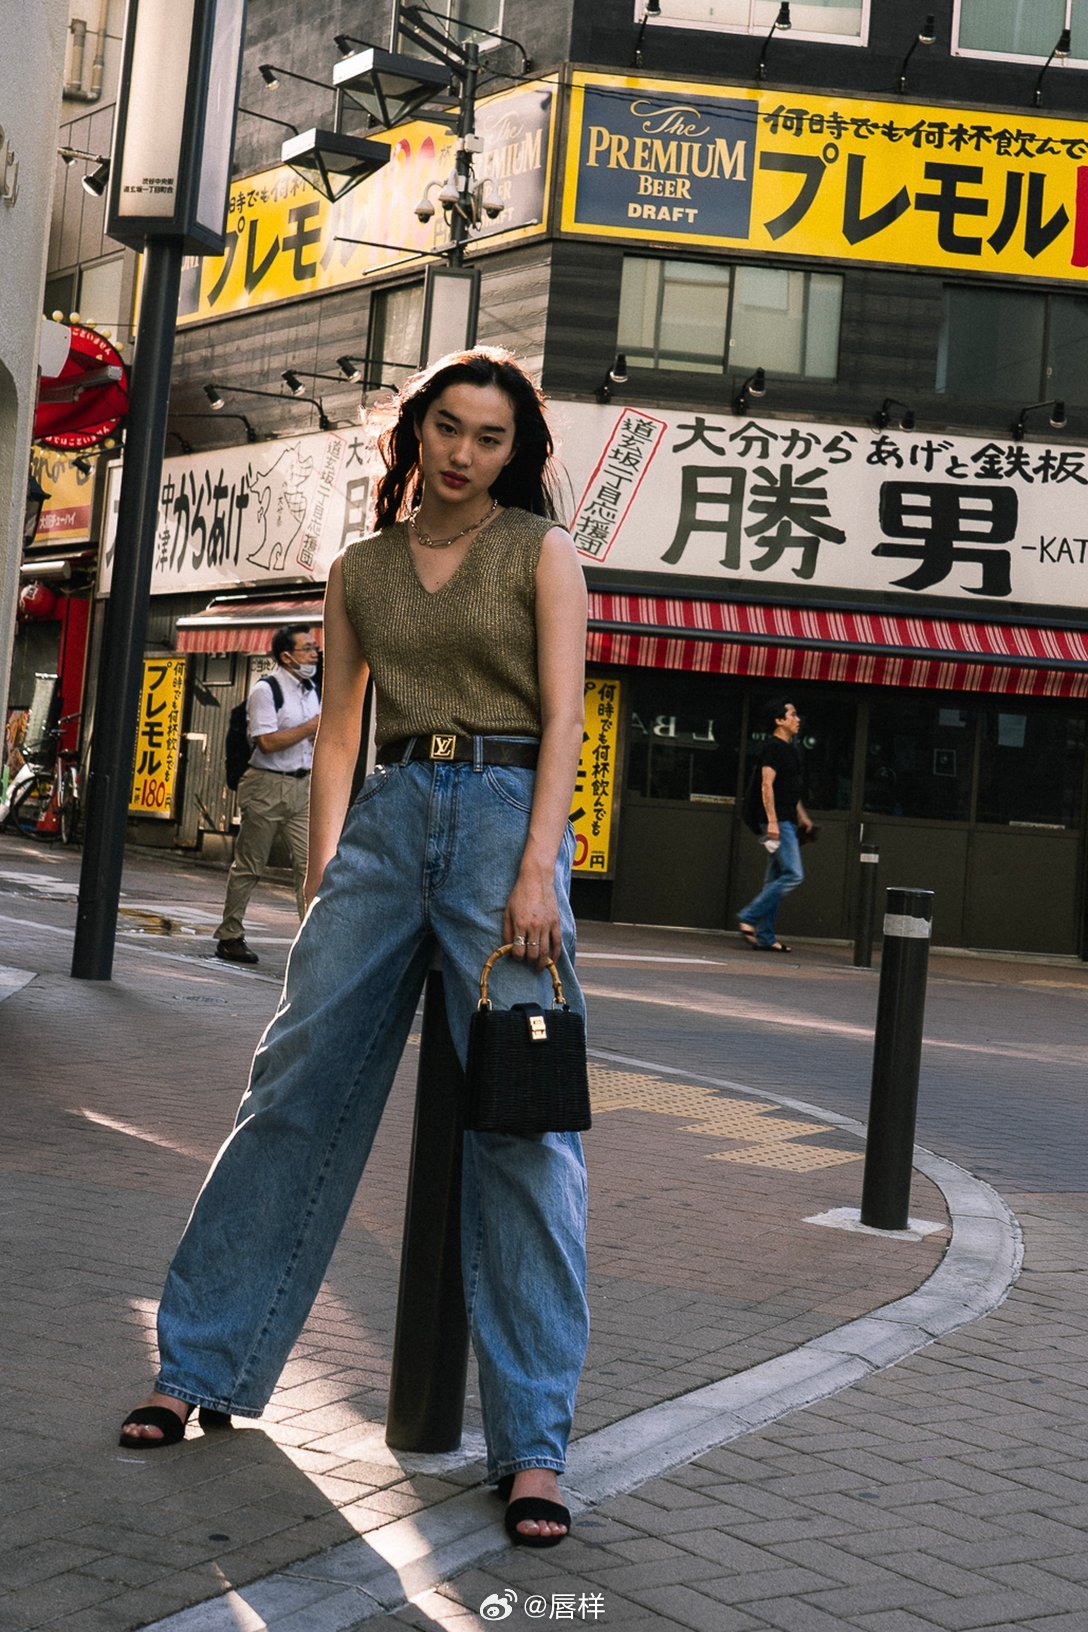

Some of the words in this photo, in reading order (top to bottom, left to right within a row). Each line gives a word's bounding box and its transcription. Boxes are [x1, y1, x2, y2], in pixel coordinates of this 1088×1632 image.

[630, 100, 710, 137] The
[586, 126, 747, 181] PREMIUM
[627, 203, 698, 223] DRAFT
[637, 174, 692, 200] BEER
[759, 142, 1069, 260] プレモル
[660, 463, 1018, 598] 勝男
[137, 661, 172, 777] プレモル
[591, 682, 617, 836] 何時でも何杯飲んでも
[141, 779, 165, 808] 180
